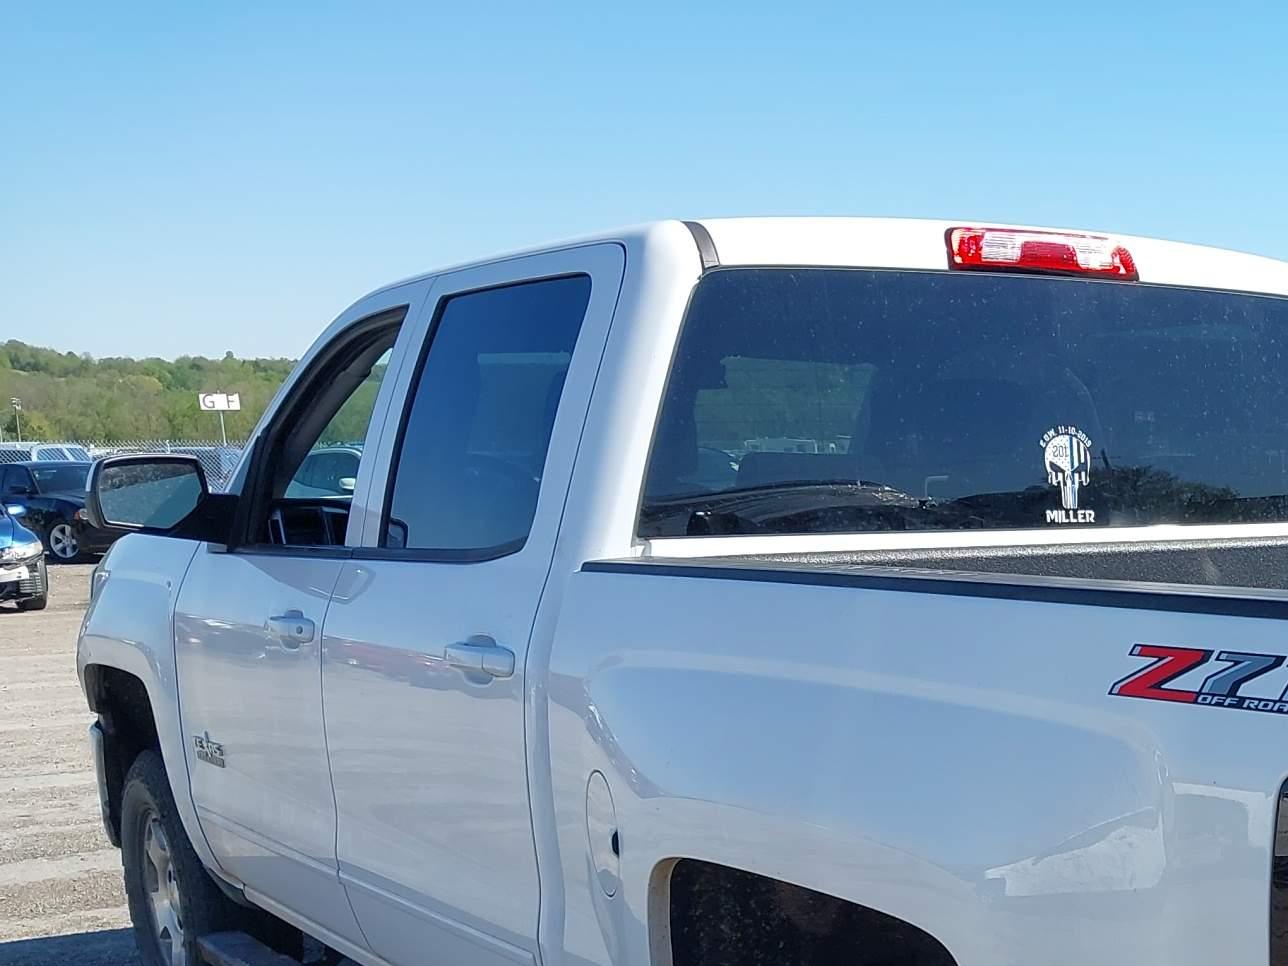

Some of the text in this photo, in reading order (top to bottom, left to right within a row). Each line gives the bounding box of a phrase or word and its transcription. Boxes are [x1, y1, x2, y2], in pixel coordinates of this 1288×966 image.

[202, 393, 216, 409] G
[1058, 425, 1093, 448] 11-10-2019
[1053, 446, 1069, 458] 201
[1045, 509, 1096, 524] MILLER
[1197, 694, 1238, 708] OFF
